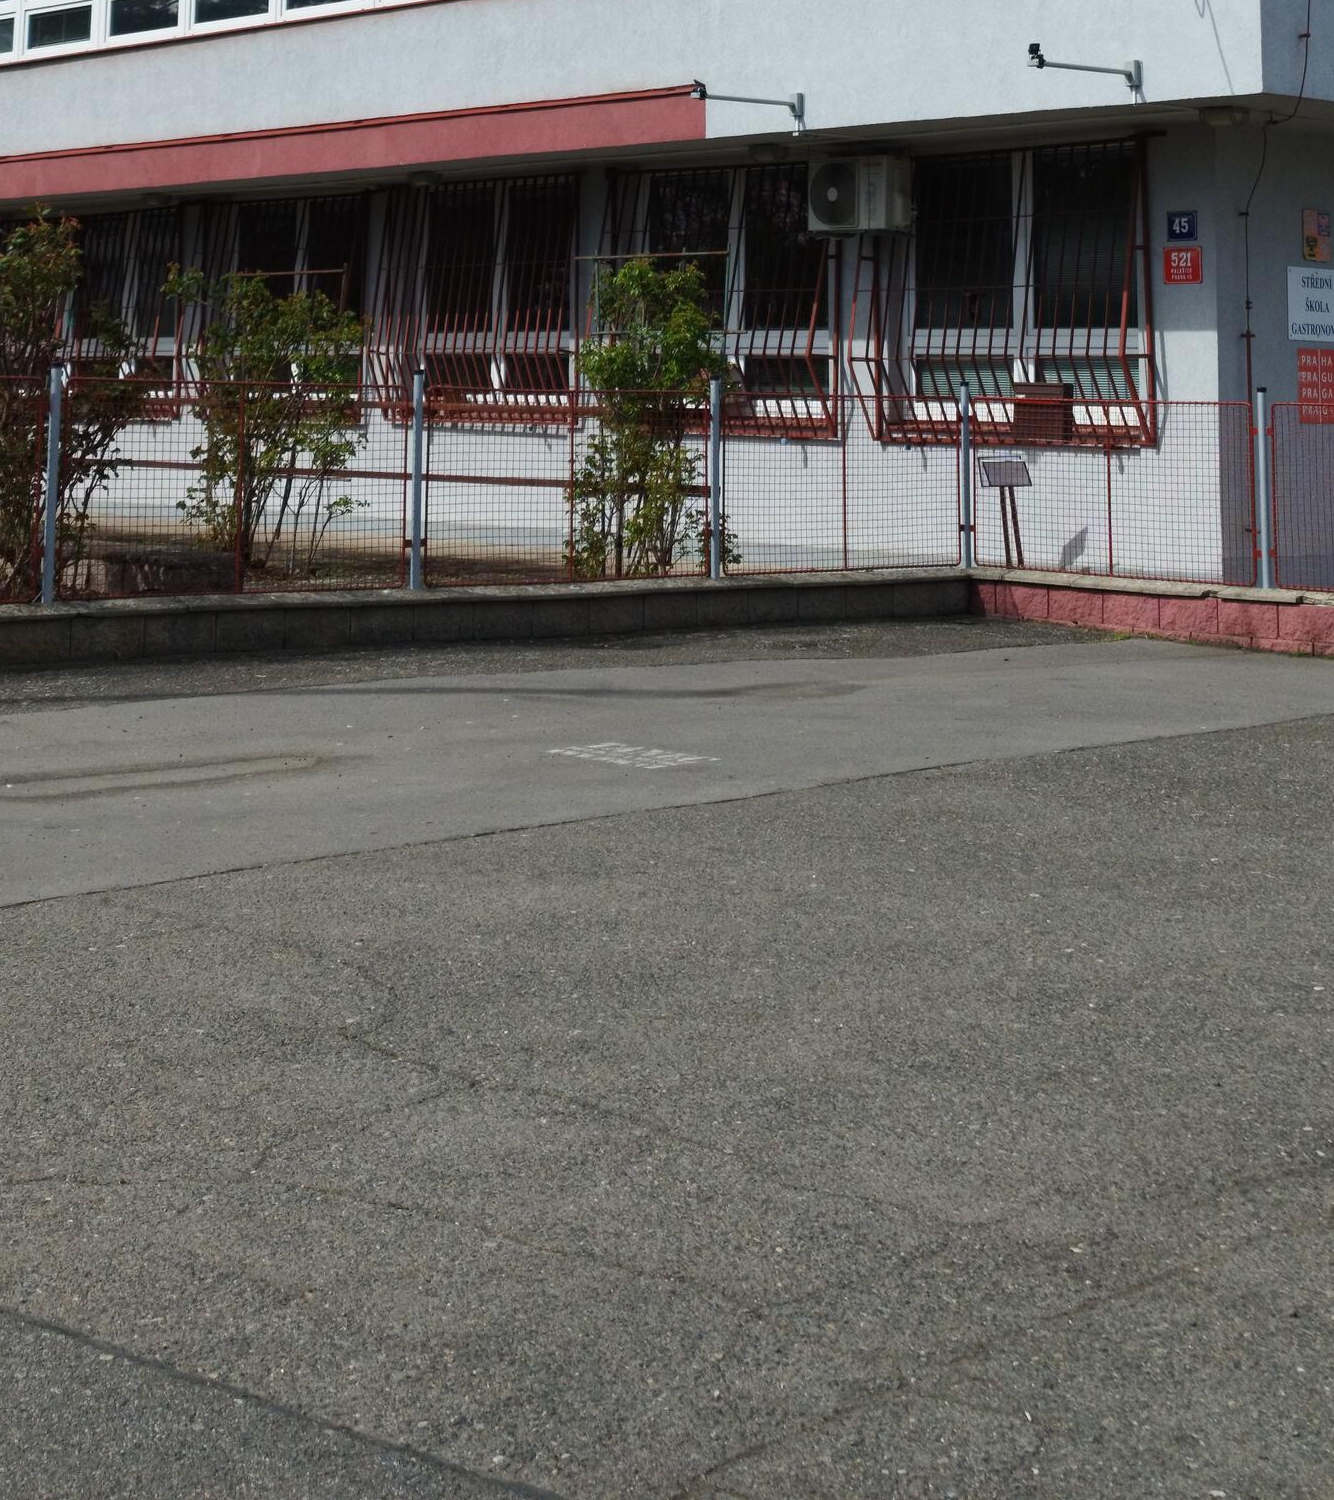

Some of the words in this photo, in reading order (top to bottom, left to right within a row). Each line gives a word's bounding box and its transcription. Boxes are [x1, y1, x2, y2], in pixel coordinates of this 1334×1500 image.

[1173, 218, 1189, 233] 45
[1171, 252, 1192, 267] 521
[1301, 274, 1332, 290] STŘEDNÍ
[1305, 297, 1330, 313] ŠKOLA
